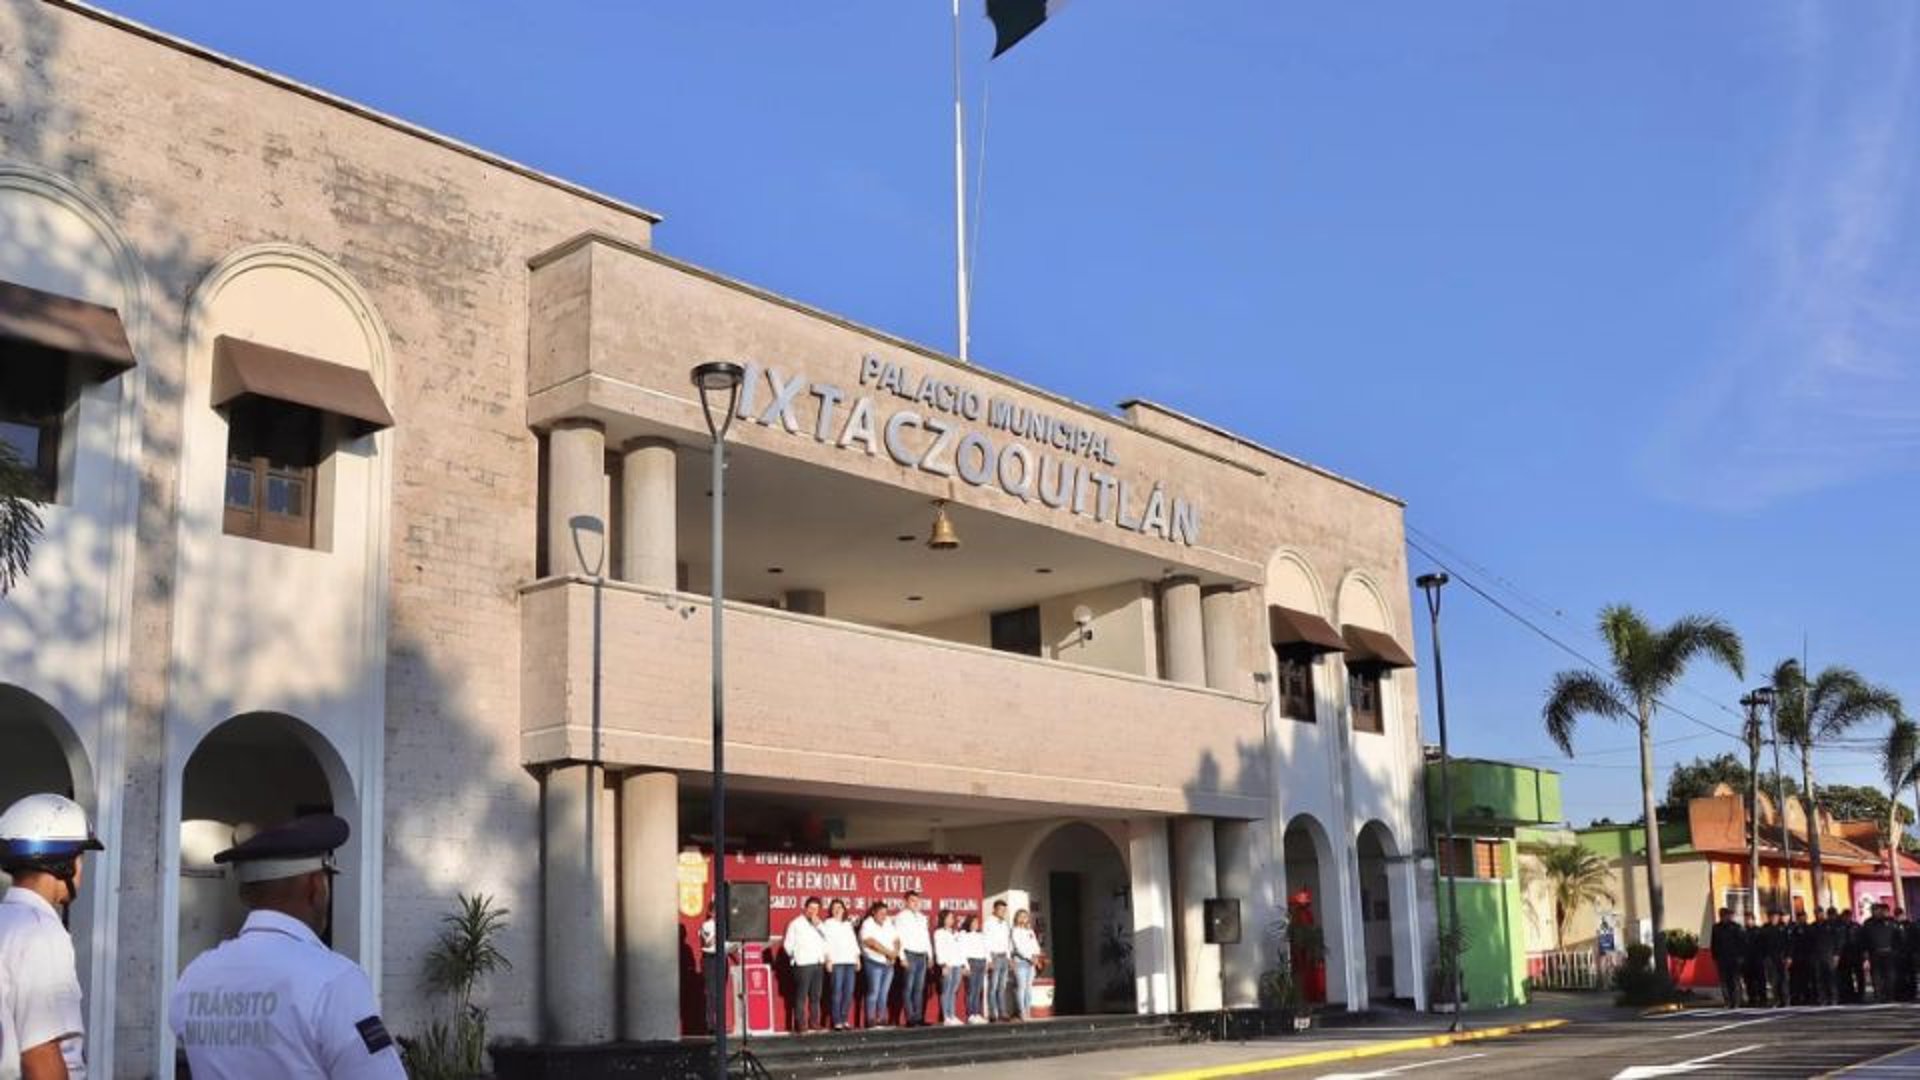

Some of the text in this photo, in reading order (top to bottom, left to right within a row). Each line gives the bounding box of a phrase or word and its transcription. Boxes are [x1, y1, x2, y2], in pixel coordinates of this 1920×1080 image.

[860, 351, 1121, 467] PALACIO MUNICIPAL
[736, 361, 1199, 546] IXTACZOQUITLÁN
[776, 870, 923, 893] CEREMONIA CIVICA
[188, 987, 278, 1016] TRÁNSITO
[185, 1018, 275, 1046] MUNICIPAL
